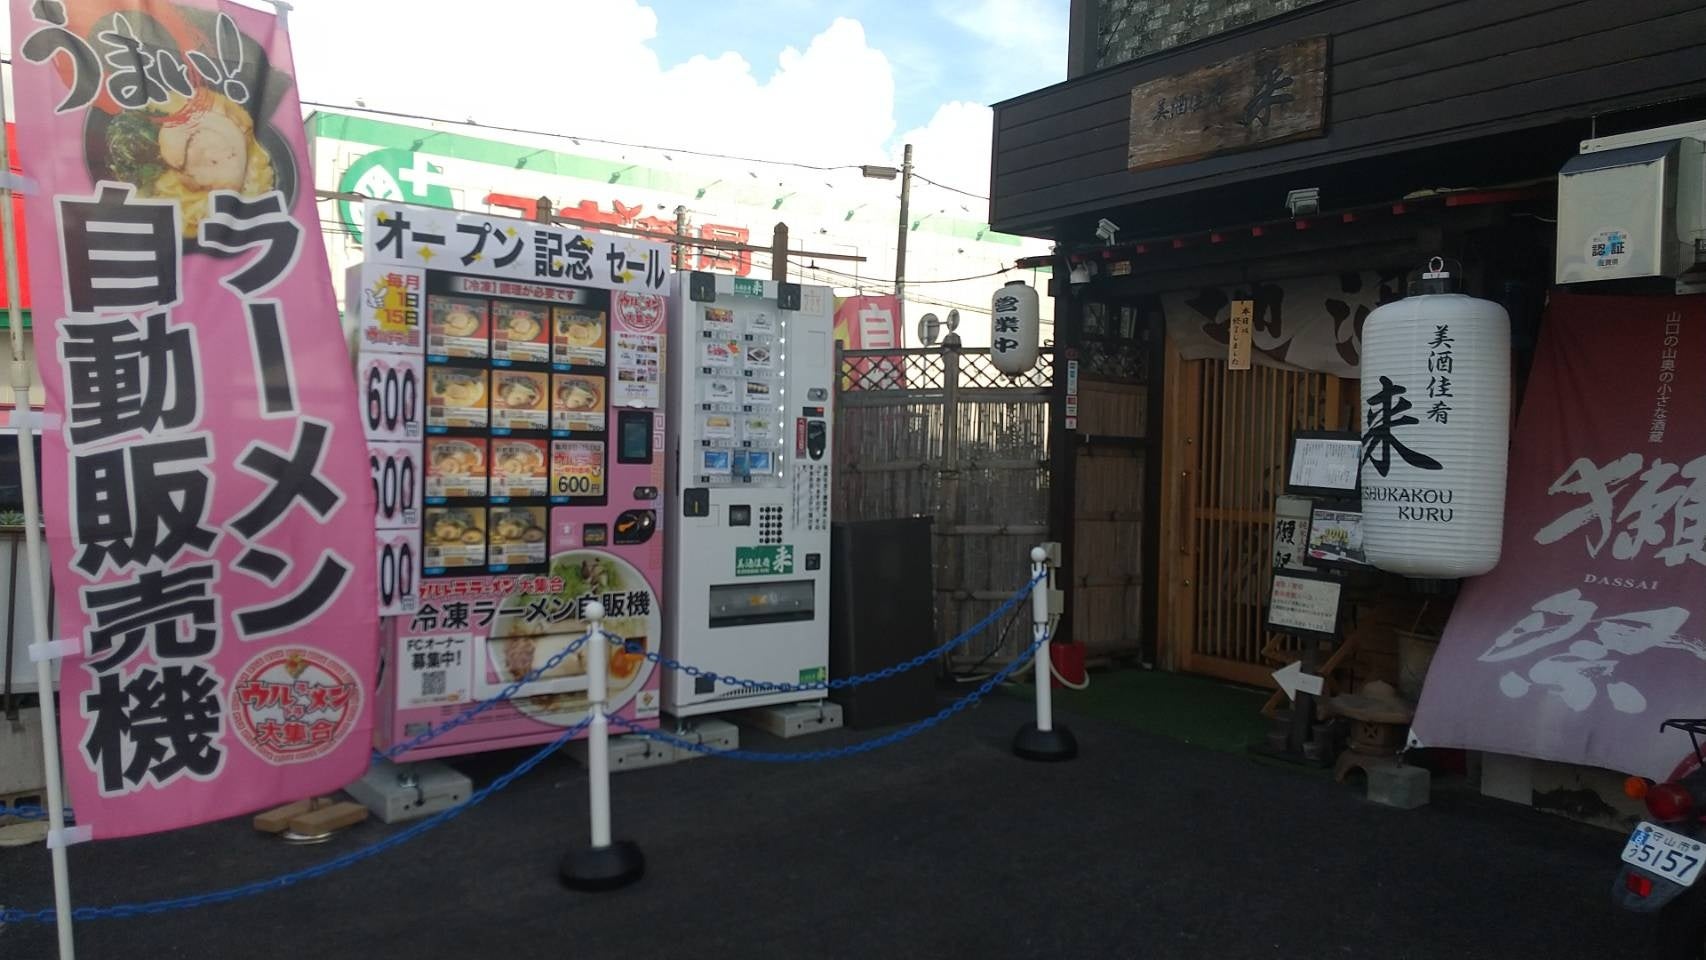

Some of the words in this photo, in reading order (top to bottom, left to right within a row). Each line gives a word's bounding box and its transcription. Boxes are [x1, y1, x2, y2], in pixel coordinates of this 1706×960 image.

[375, 211, 524, 268] オープン
[534, 230, 594, 281] 記念
[606, 243, 666, 290] セール
[1592, 241, 1625, 257] 認証
[384, 309, 419, 327] 15日
[994, 296, 1020, 354] 営業中
[1426, 324, 1456, 425] 美酒佳肴
[1648, 311, 1682, 443] 山口の山奥の小さな酒蔵
[199, 190, 353, 638] ラーメン
[1361, 375, 1444, 478] 来
[57, 184, 226, 796] 自動販売機
[1398, 506, 1454, 523] KURU
[1584, 574, 1659, 590] DASSAI
[258, 721, 334, 746] 大集合
[1638, 844, 1699, 878] 5157
[1652, 831, 1691, 853] 守山市
